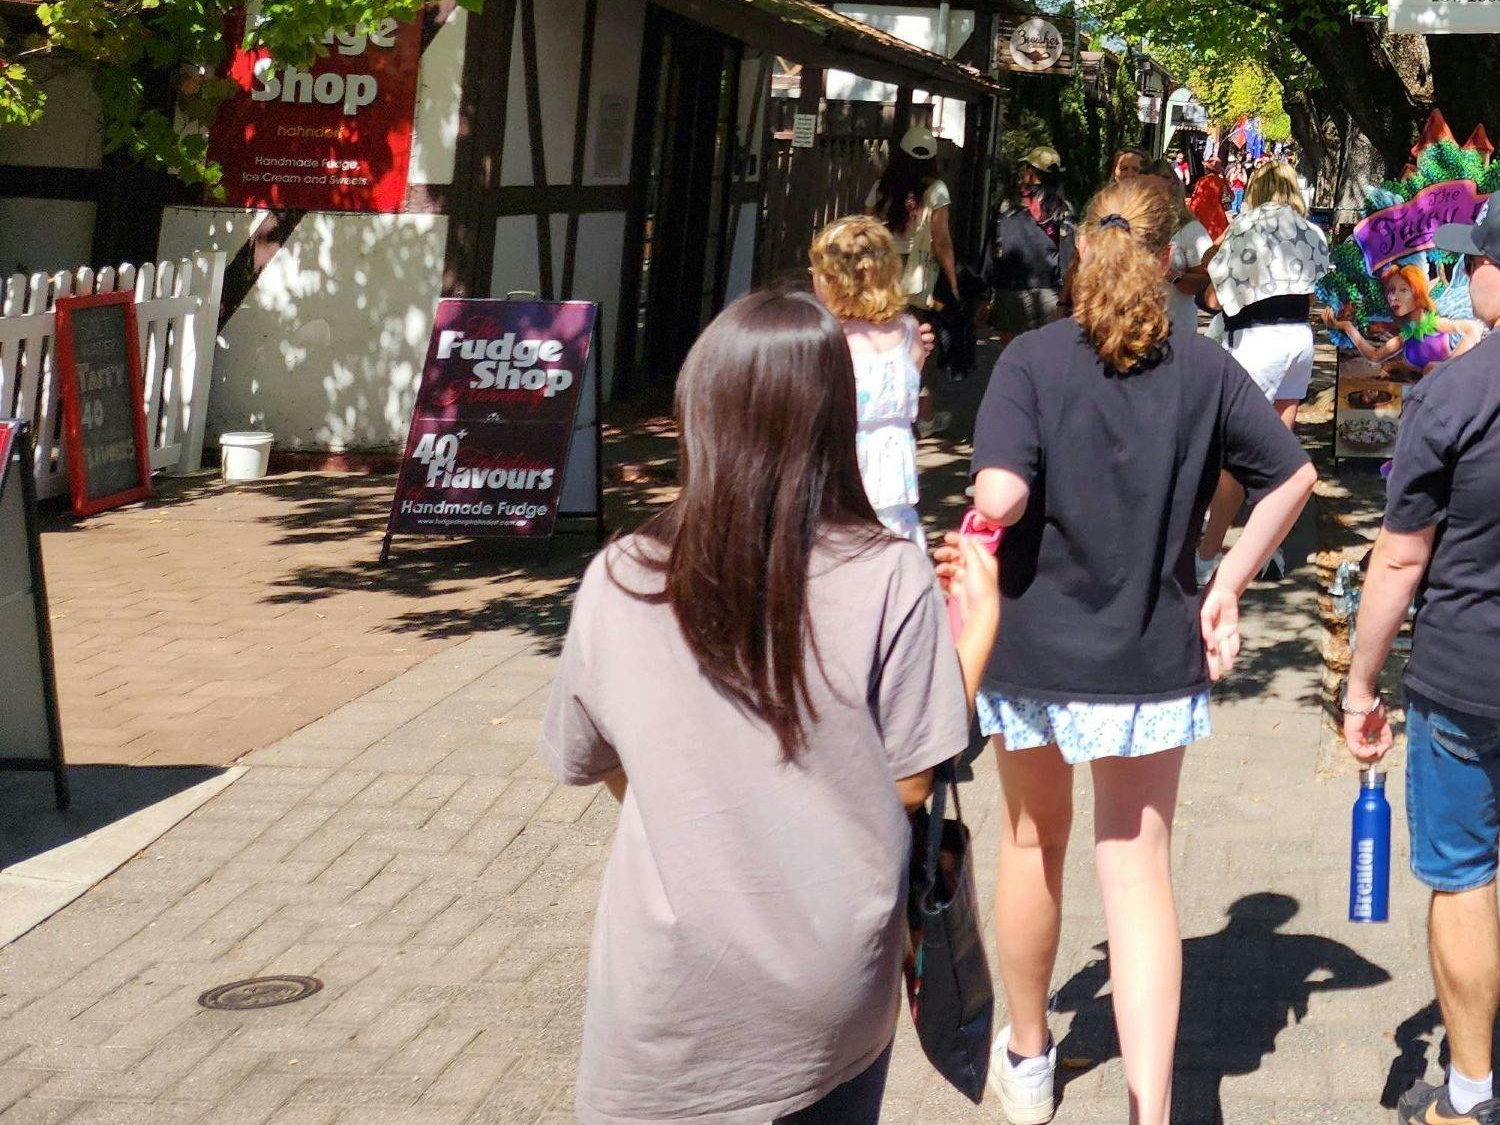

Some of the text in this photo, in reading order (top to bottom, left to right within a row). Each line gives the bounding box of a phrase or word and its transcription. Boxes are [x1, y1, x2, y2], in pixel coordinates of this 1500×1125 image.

[251, 55, 378, 116] Shop
[242, 172, 260, 182] Ice
[262, 172, 301, 184] Cream
[303, 175, 327, 184] and
[254, 156, 319, 168] Handmade
[1427, 189, 1462, 206] The
[436, 330, 564, 367] Fudge
[469, 361, 573, 397] Shop
[427, 459, 555, 491] Flavours
[400, 500, 548, 519] Handmade Fudge
[1354, 839, 1373, 918] Brenton
